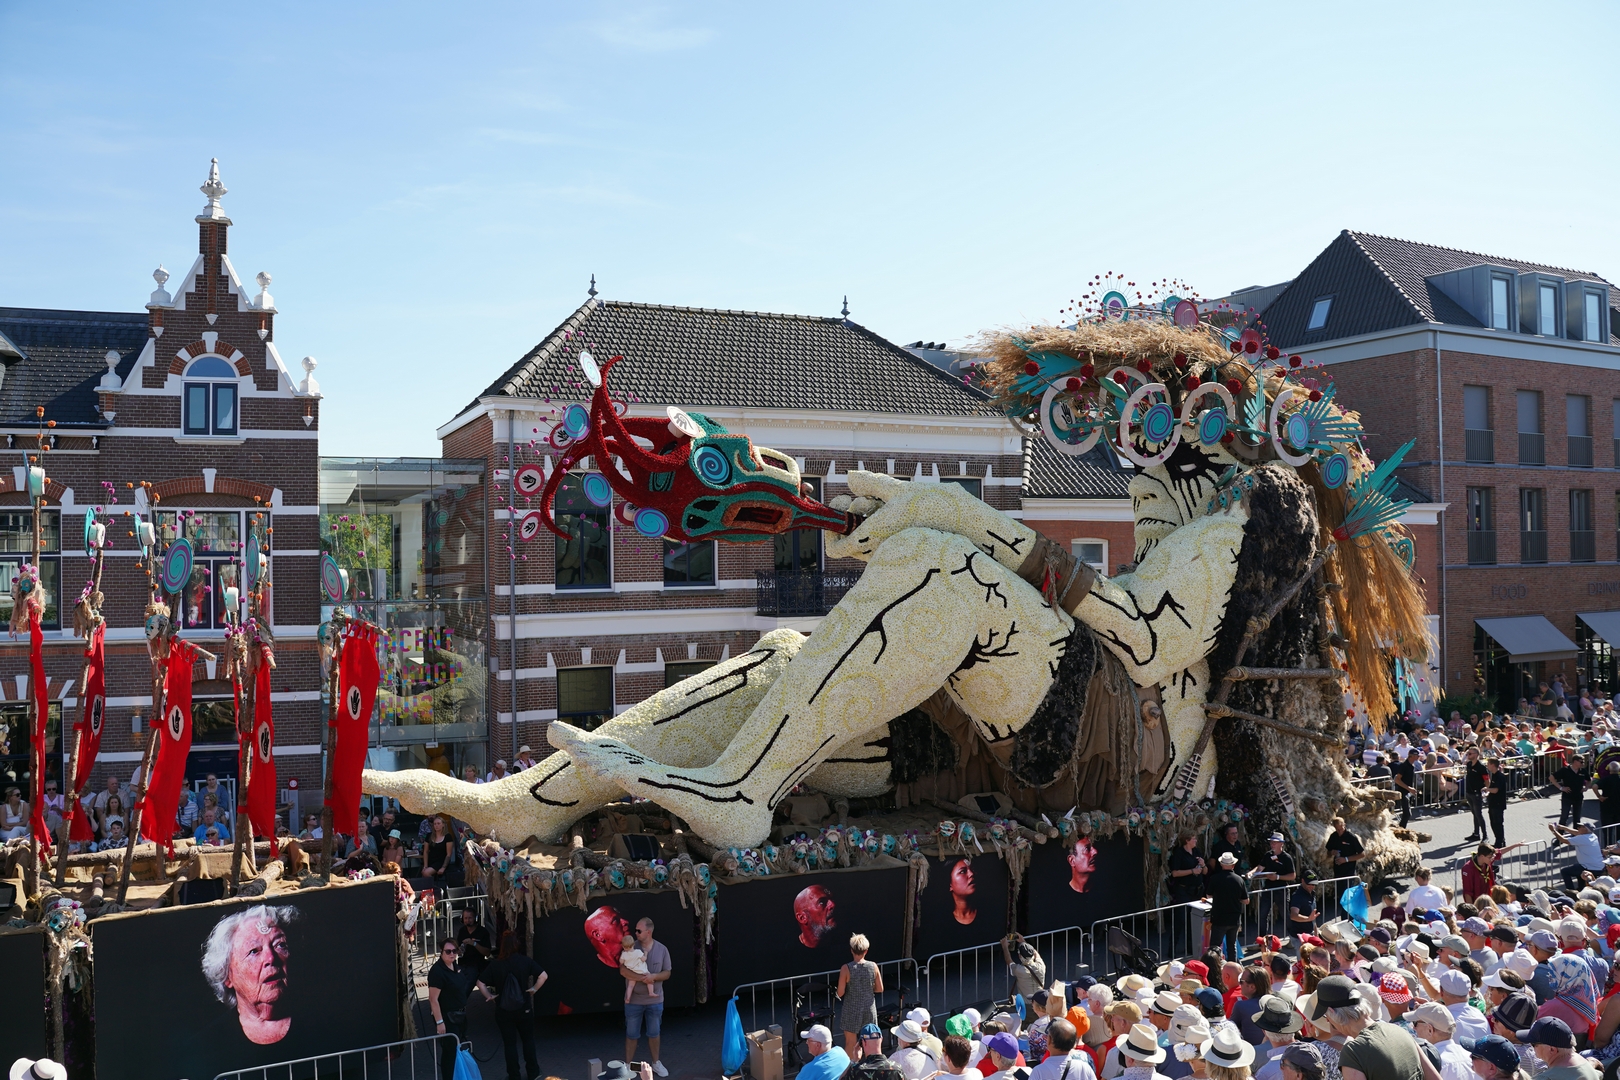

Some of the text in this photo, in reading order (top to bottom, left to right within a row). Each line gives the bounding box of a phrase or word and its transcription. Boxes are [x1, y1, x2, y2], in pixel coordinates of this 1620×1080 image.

[1491, 583, 1527, 600] FOOD
[358, 628, 454, 653] INCENT
[380, 695, 433, 719] HUIS
